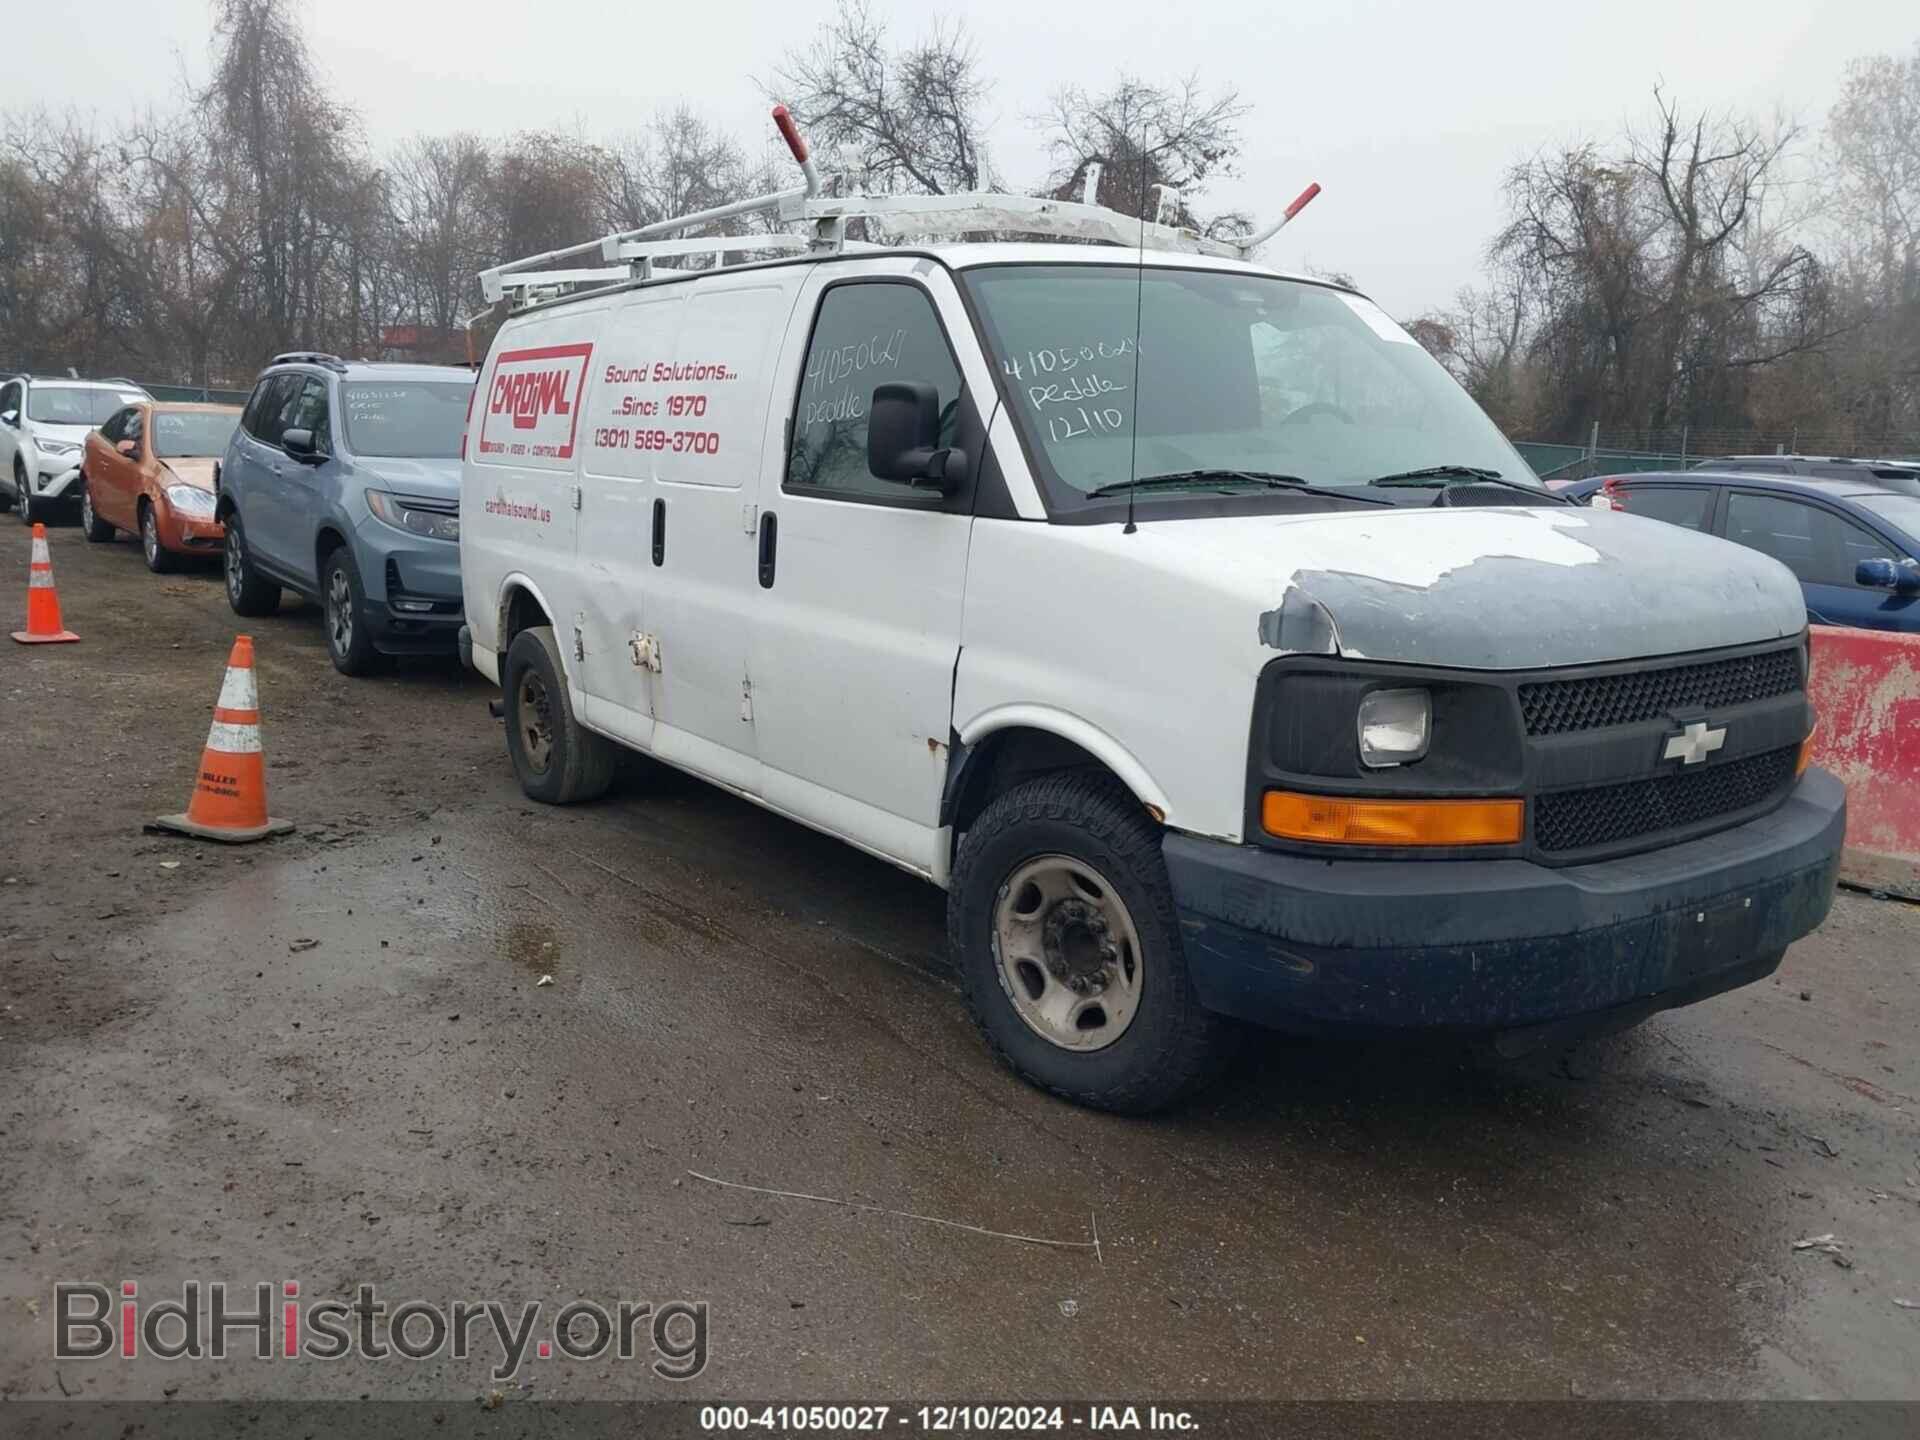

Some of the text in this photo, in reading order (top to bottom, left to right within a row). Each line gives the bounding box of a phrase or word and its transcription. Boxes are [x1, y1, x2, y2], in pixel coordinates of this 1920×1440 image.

[605, 361, 738, 383] Sound Solutions...
[612, 395, 708, 417] ...Since 1970
[1048, 407, 1122, 443] 12/10
[594, 428, 720, 455] (301) 589-3700
